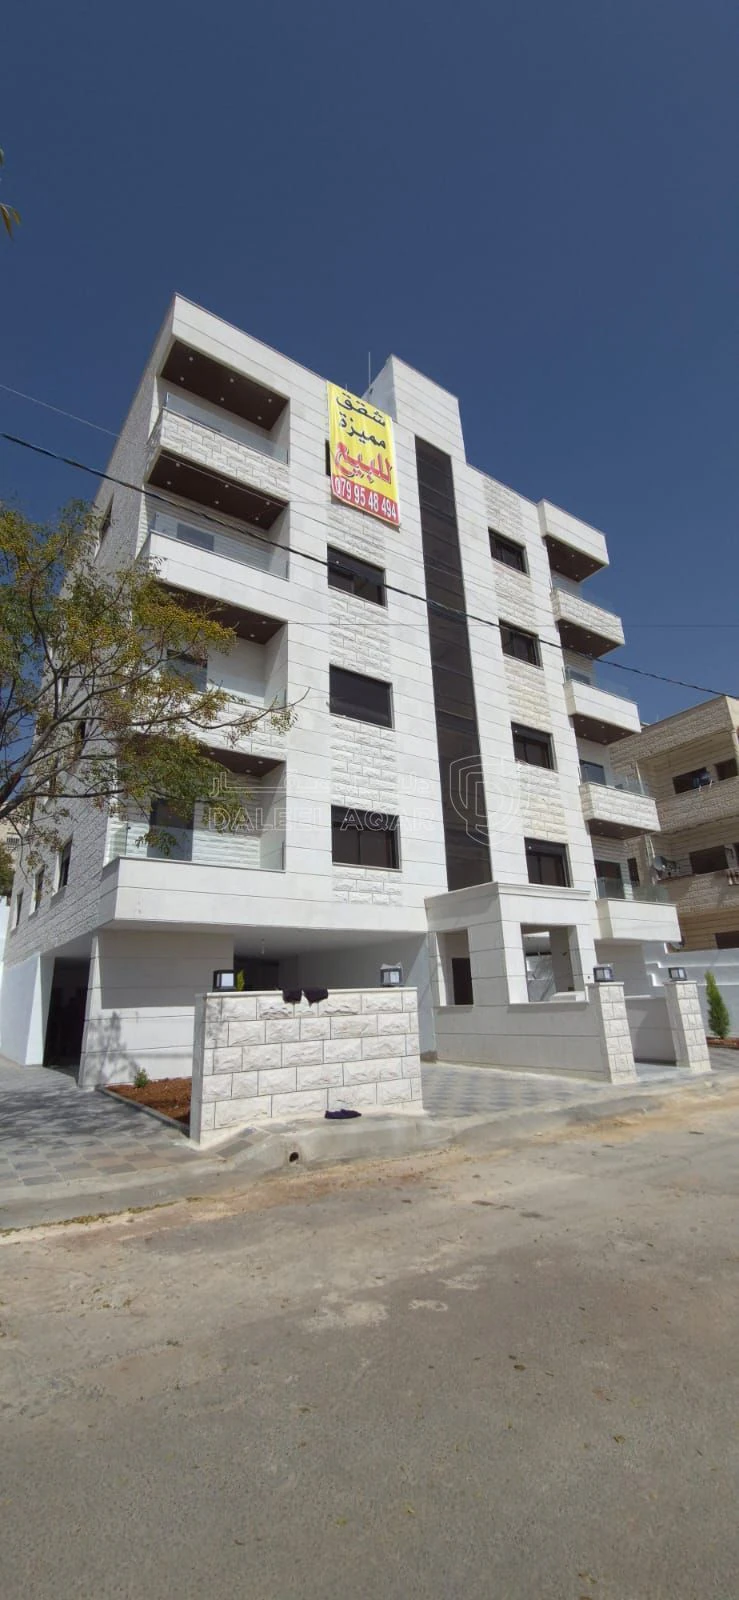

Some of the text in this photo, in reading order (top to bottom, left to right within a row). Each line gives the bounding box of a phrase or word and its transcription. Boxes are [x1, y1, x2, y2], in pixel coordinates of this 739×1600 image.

[336, 392, 386, 427] شقق
[339, 411, 386, 449] مميزة
[335, 441, 392, 485] للبيع
[334, 476, 396, 520] 079 95 48 494
